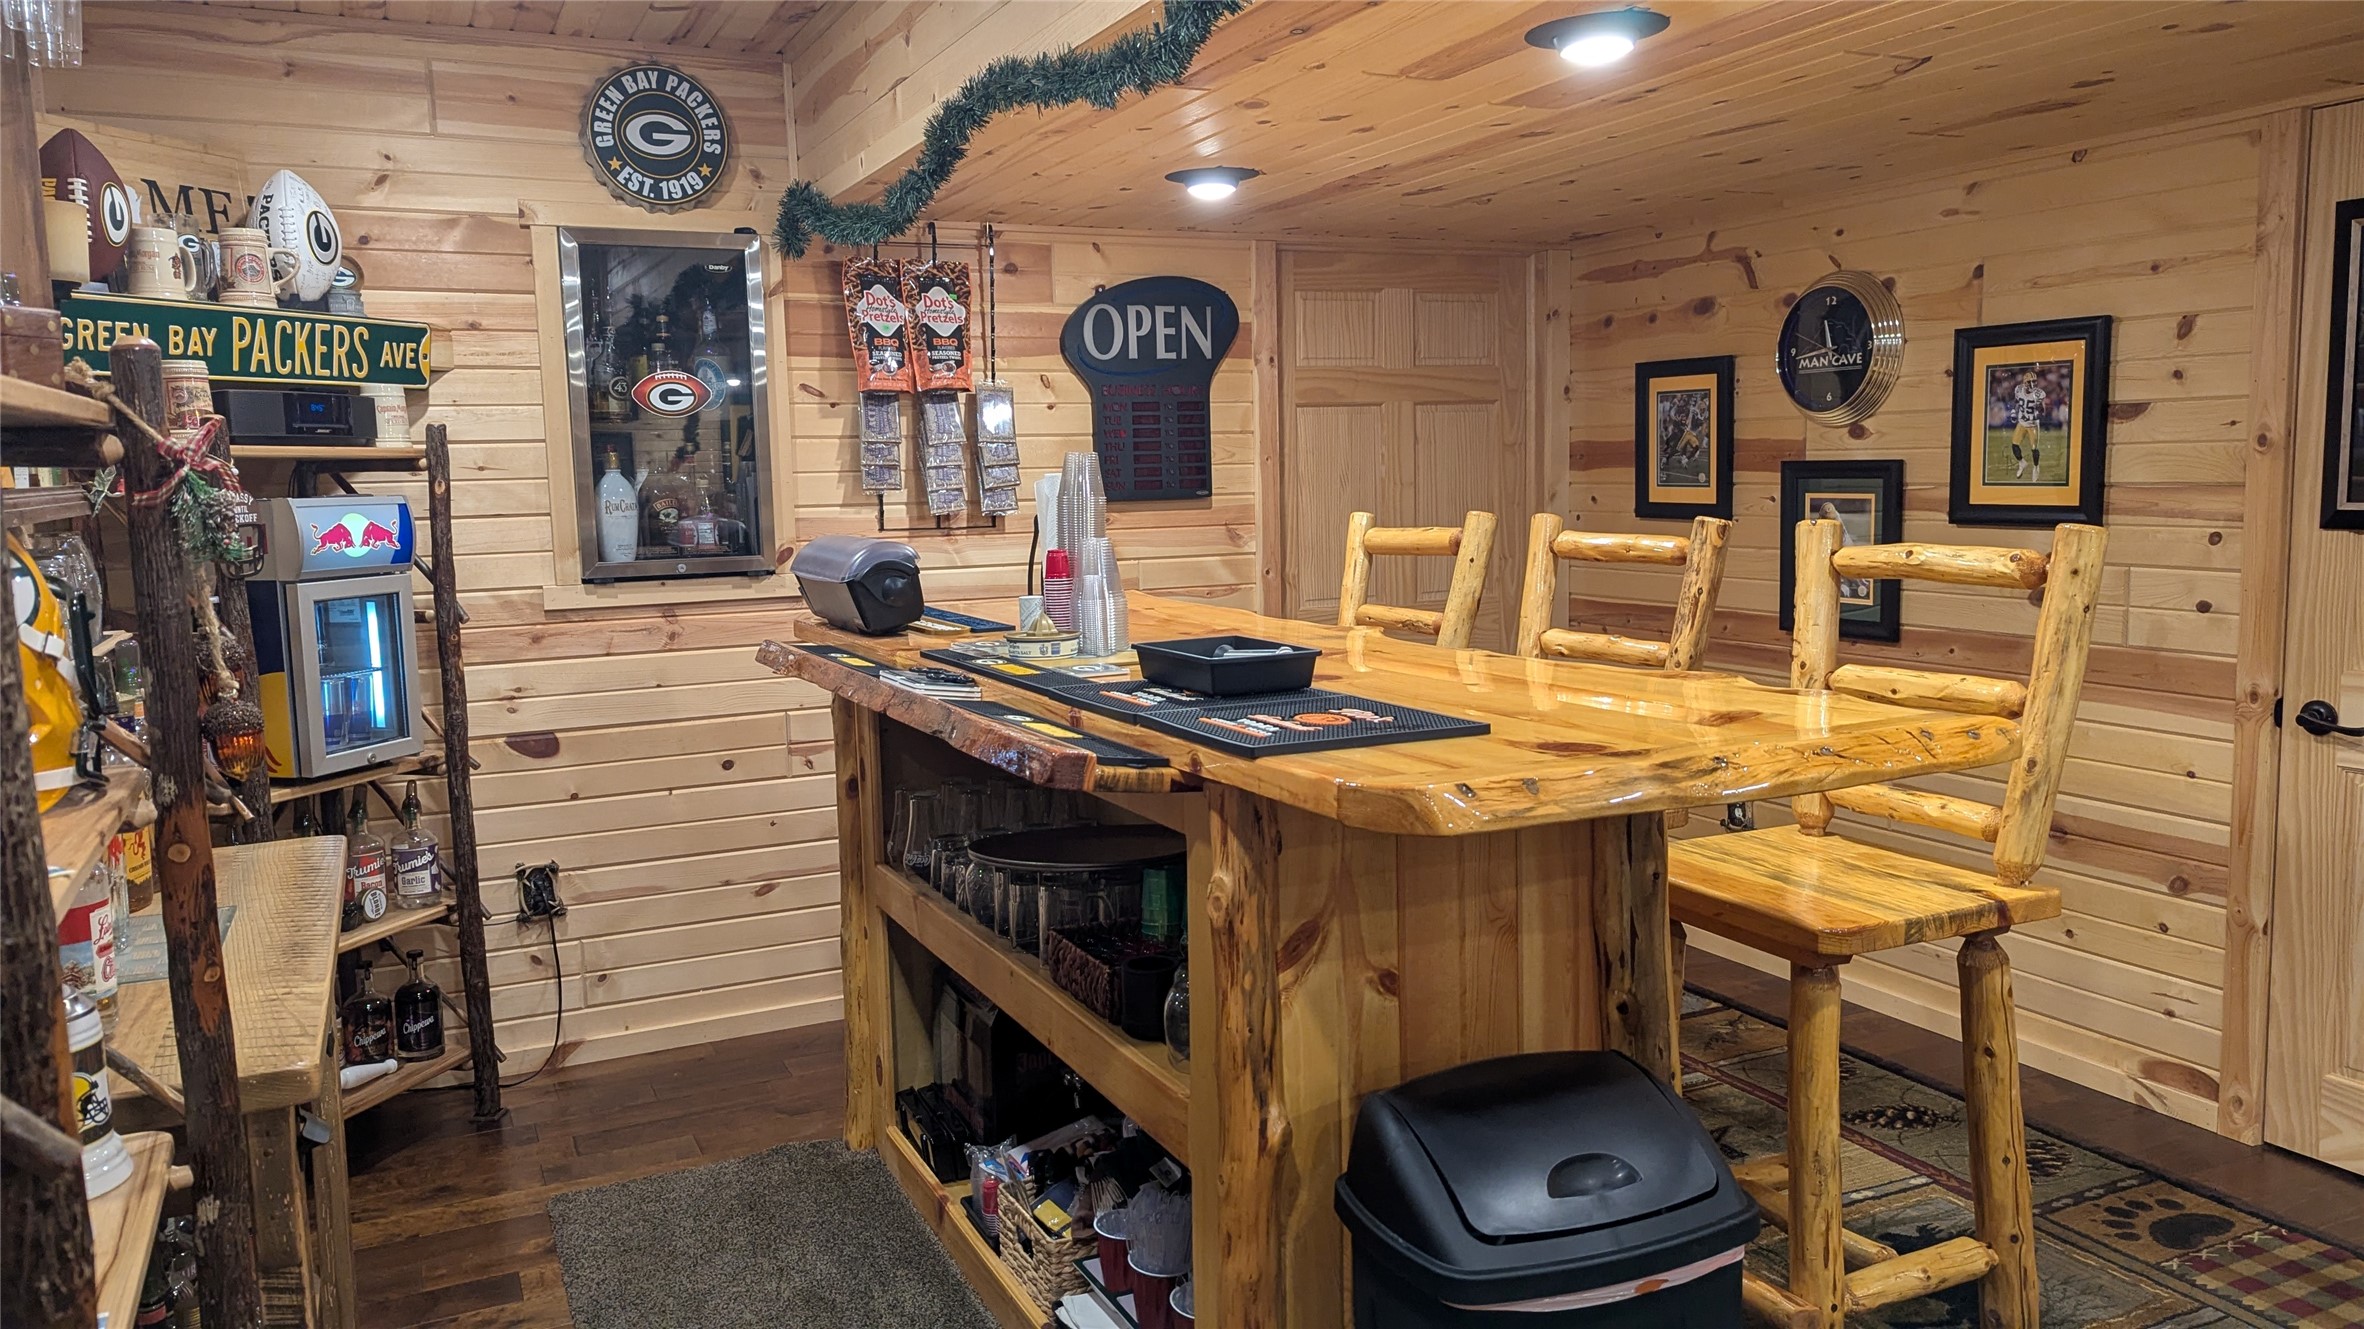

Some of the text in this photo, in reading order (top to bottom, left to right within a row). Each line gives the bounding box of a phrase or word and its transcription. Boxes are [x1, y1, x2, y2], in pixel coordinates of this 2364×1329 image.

[594, 71, 722, 155] GREEN BAY PACKERS
[626, 114, 691, 155] G
[616, 166, 704, 200] EST. 1919
[865, 291, 896, 308] Dot's
[923, 294, 954, 310] Dot's
[1826, 296, 1837, 306] 12
[862, 309, 903, 323] Pretzels
[920, 311, 964, 324] Pretzels
[1083, 303, 1213, 361] OPEN
[168, 325, 217, 357] BAY
[232, 316, 369, 379] PACKERS
[380, 341, 417, 369] AVE
[873, 337, 899, 347] BBQ
[933, 338, 958, 347] BBQ
[1867, 341, 1873, 350] 3
[1790, 348, 1797, 357] 9
[1798, 352, 1863, 369] MAN CAVE
[613, 382, 628, 393] 43
[649, 383, 695, 412] G
[1826, 392, 1832, 401] 6
[401, 875, 426, 886] Garlic
[403, 1015, 435, 1035] Chippewa
